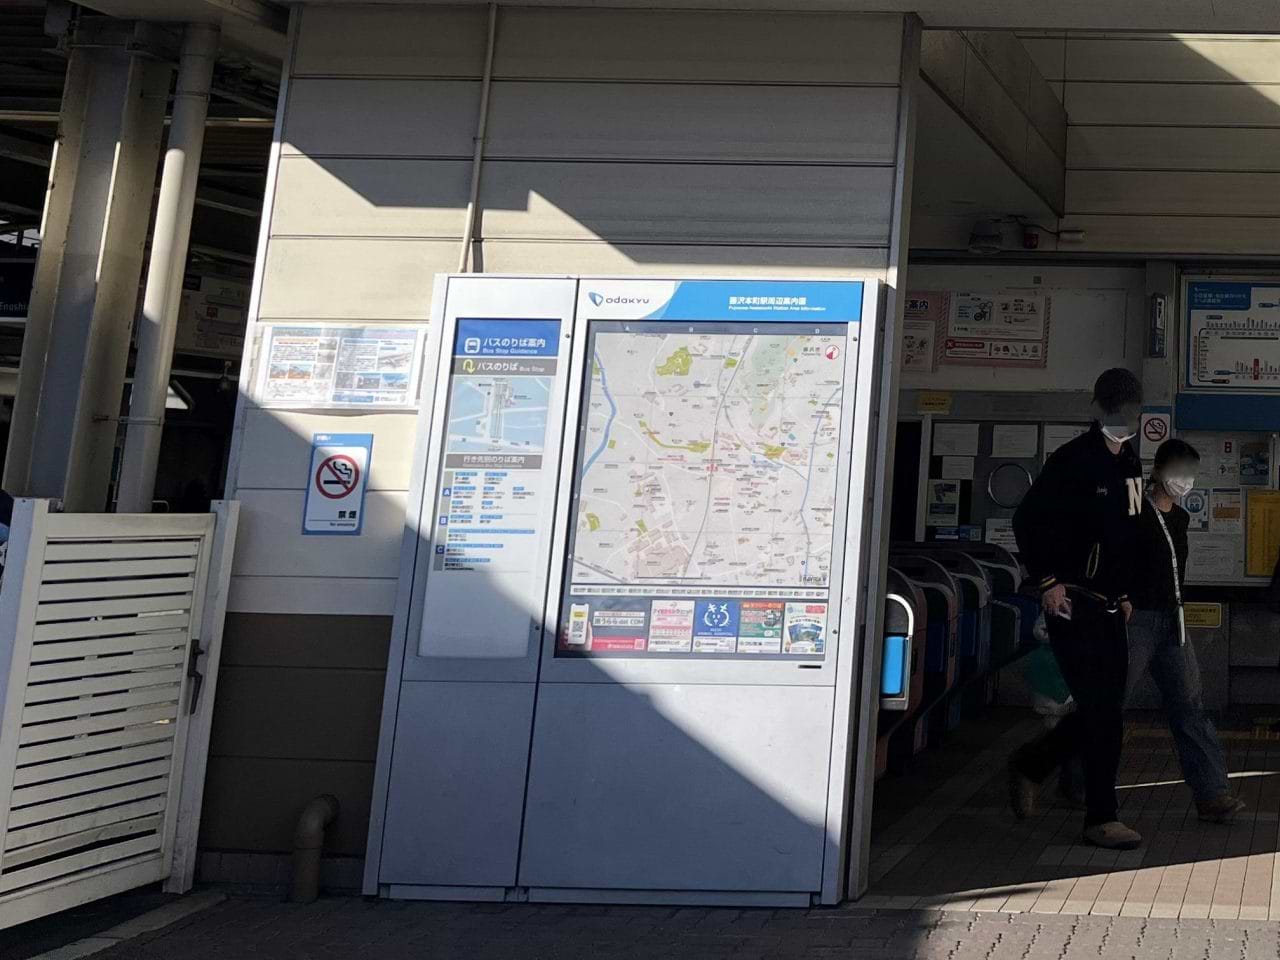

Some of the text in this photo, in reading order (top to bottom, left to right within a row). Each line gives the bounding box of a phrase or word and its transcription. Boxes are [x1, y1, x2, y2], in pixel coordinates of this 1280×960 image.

[483, 338, 546, 348] バスのりば案内
[477, 362, 519, 371] バスのりば
[1126, 477, 1142, 516] N
